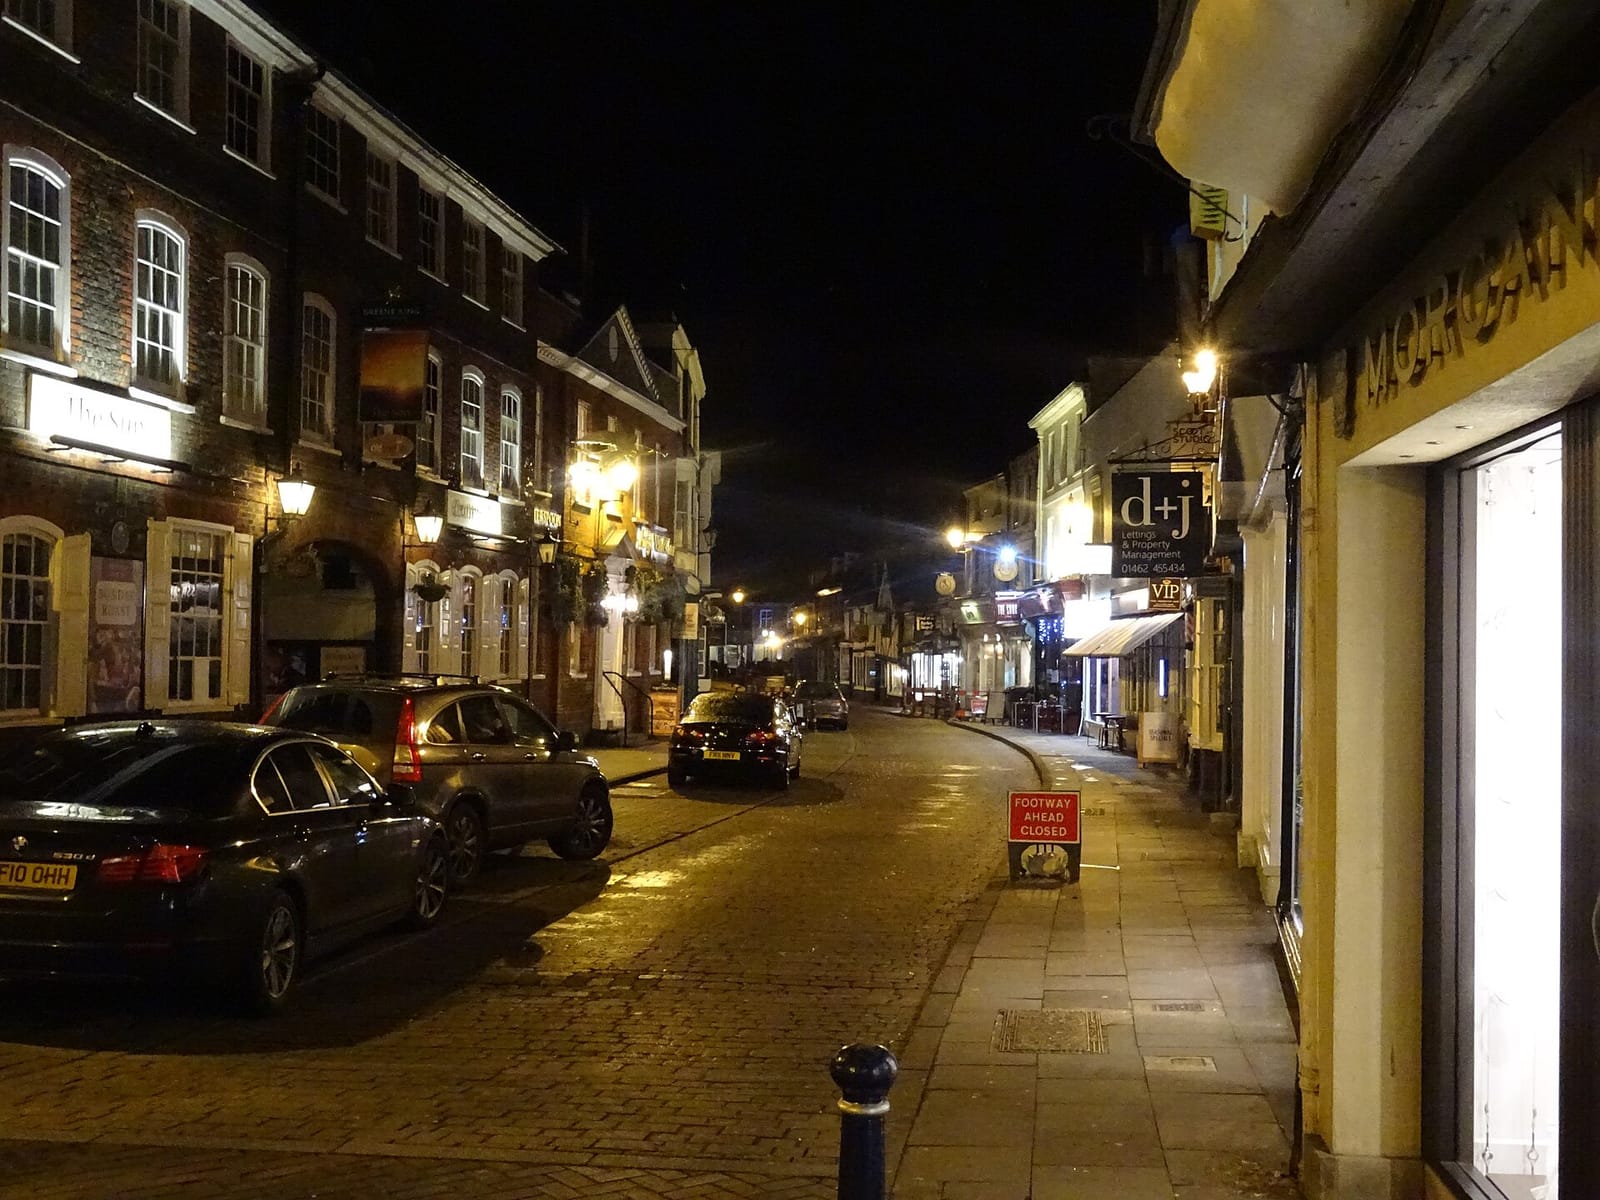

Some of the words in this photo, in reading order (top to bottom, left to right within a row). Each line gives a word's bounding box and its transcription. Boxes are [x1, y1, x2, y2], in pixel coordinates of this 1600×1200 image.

[63, 391, 103, 428] The
[108, 411, 145, 434] Sun
[1173, 436, 1210, 444] STUDIO
[1121, 477, 1194, 539] d+j
[1121, 531, 1156, 541] Lettings
[1122, 541, 1130, 549] &
[1132, 541, 1170, 551] Property
[1121, 551, 1181, 560] Management
[1121, 564, 1148, 573] 01462
[1152, 563, 1185, 573] 455434
[1151, 583, 1179, 599] VIP
[1015, 797, 1071, 809] FOOTWAY
[1024, 812, 1064, 822] AHEAD
[1020, 825, 1067, 837] CLOSED
[32, 865, 71, 885] OHH
